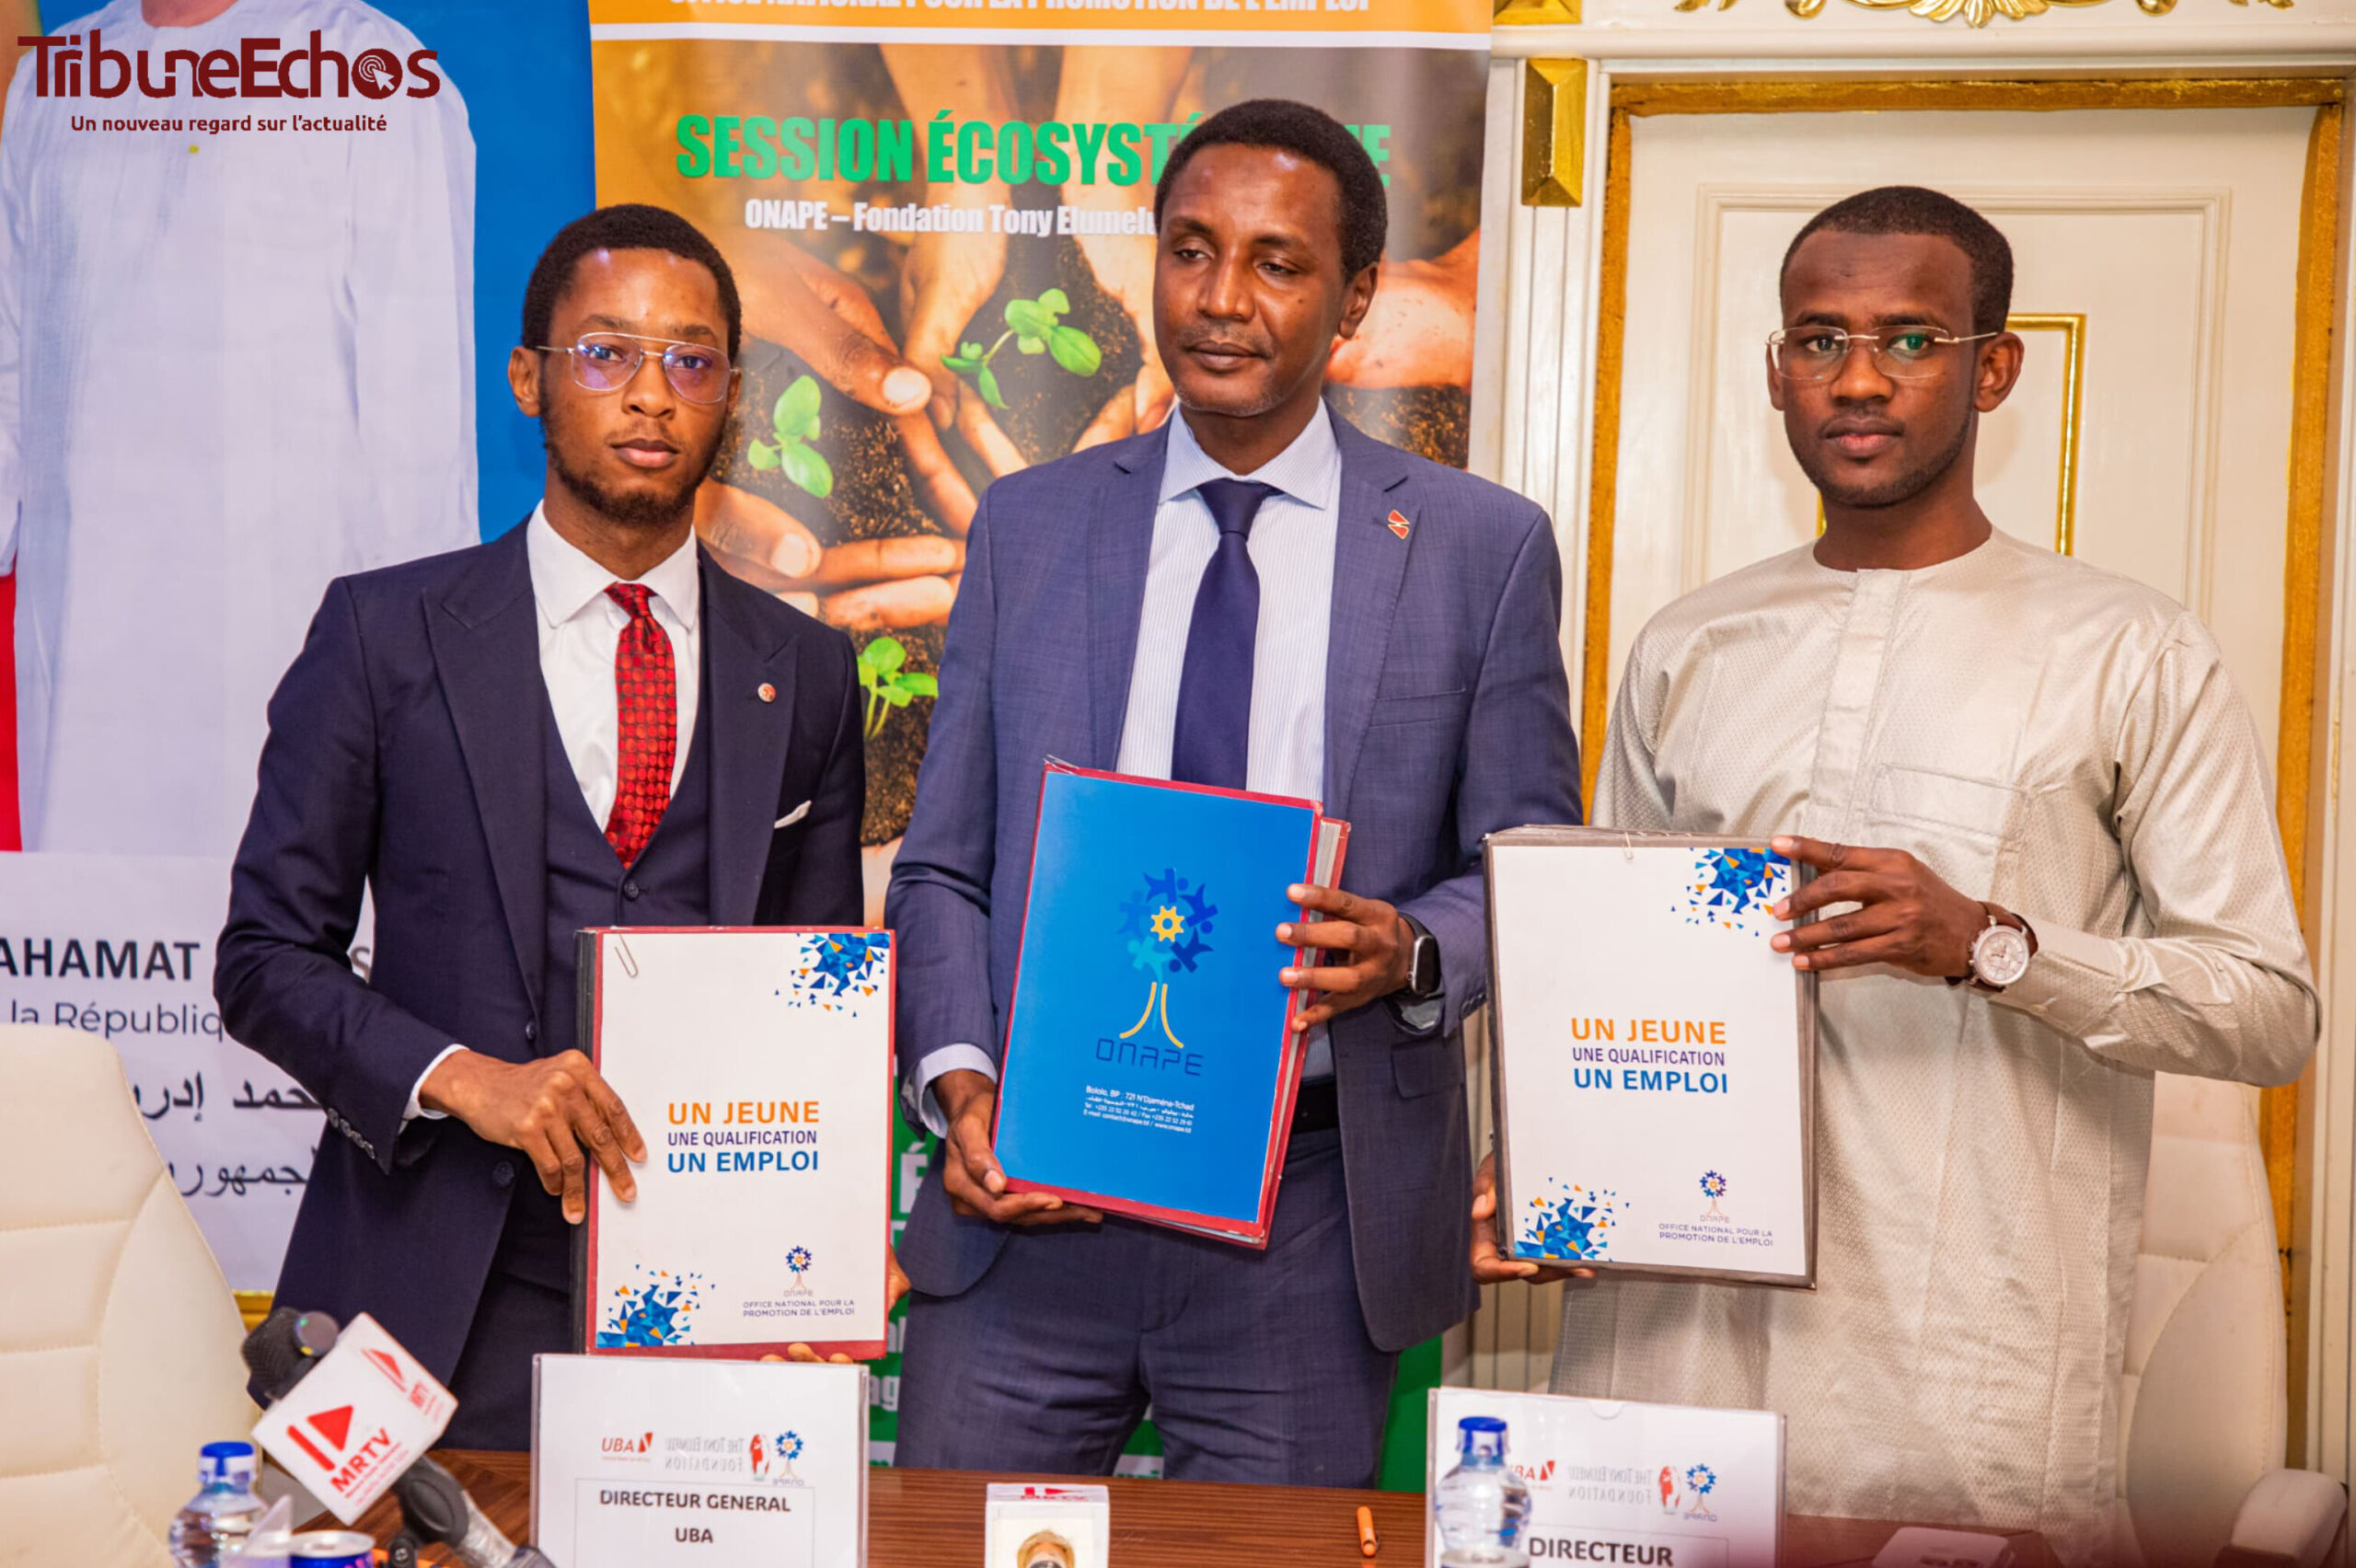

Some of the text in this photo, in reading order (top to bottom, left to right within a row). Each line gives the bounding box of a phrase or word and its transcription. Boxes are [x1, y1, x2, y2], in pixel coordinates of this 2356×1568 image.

[676, 114, 913, 183] SESSION
[745, 198, 828, 230] ONAPE
[853, 202, 985, 232] Fondation
[988, 204, 1053, 237] Tony
[1571, 1017, 1727, 1044] UN JEUNE
[1096, 1038, 1204, 1077] ONAPE
[1572, 1047, 1725, 1066] UNE QUALIFICATION
[1574, 1067, 1727, 1093] UN EMPLOI
[668, 1101, 819, 1124] UN JEUNE
[668, 1130, 817, 1147] UNE QUALIFICATION
[667, 1150, 819, 1172] UN EMPLOI
[1658, 1223, 1689, 1231] OFFICE
[1692, 1226, 1734, 1234] NATIONAL
[1737, 1228, 1760, 1236] POUR
[1659, 1231, 1715, 1242] PROMOTION
[743, 1309, 797, 1318] PROMOTION
[800, 1309, 811, 1317] DE
[601, 1437, 634, 1453] UBA
[329, 1426, 390, 1493] MRTV
[600, 1490, 791, 1513] DIRECTEUR GENERAL
[675, 1528, 713, 1543] UBA
[1529, 1537, 1674, 1567] DIRECTEUR
